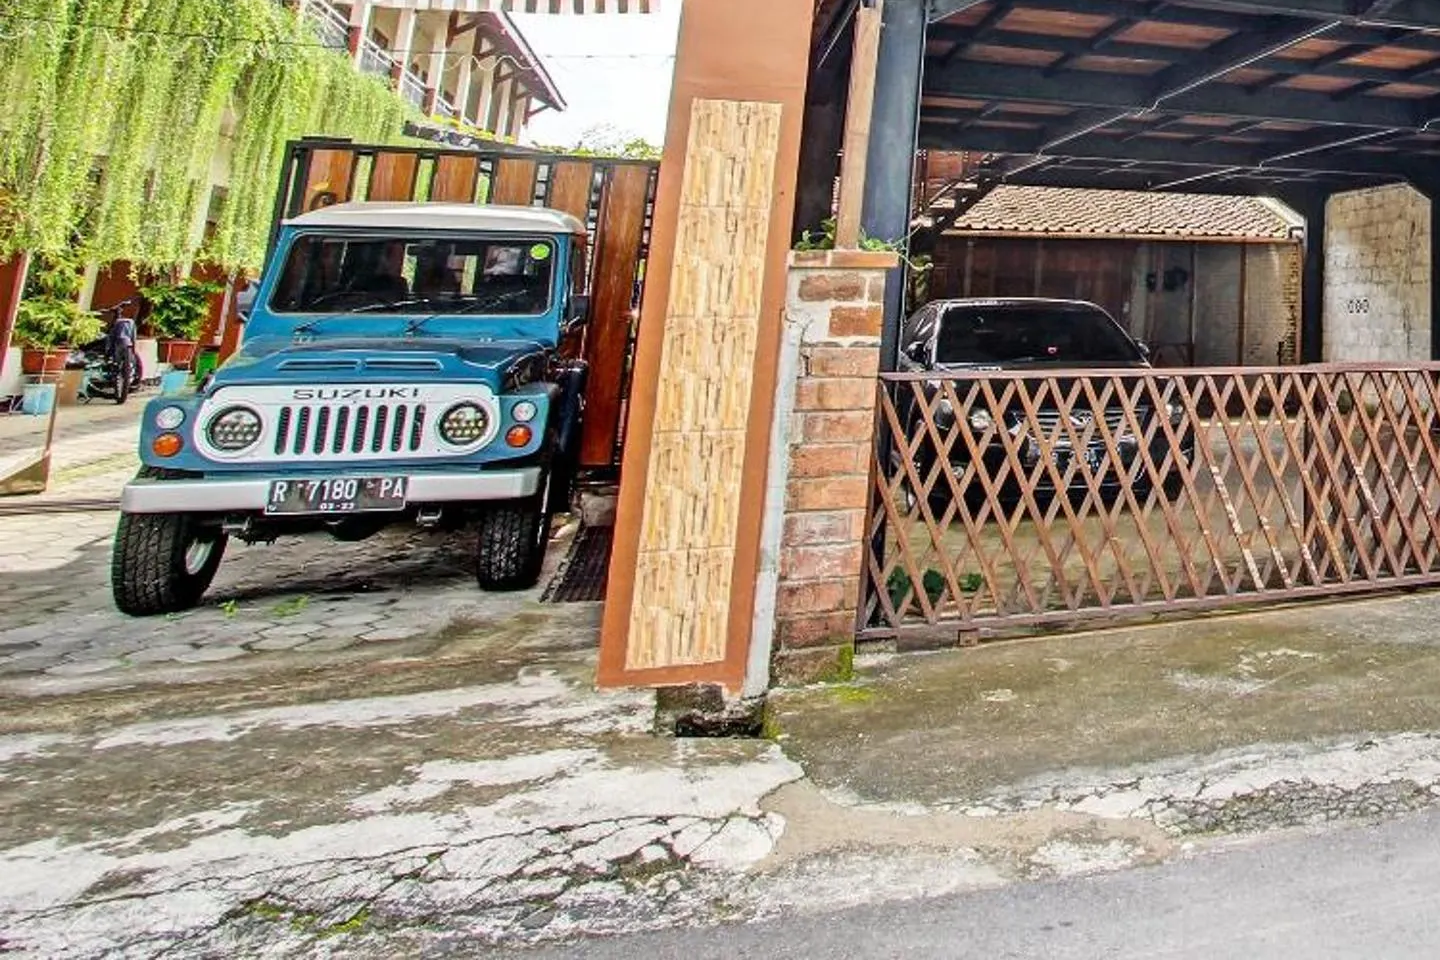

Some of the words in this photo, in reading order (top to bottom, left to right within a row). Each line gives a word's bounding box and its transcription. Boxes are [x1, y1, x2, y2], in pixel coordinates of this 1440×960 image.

[293, 388, 419, 400] SUZUKI
[272, 481, 288, 502] R
[306, 480, 358, 501] 7180
[379, 480, 404, 498] PA
